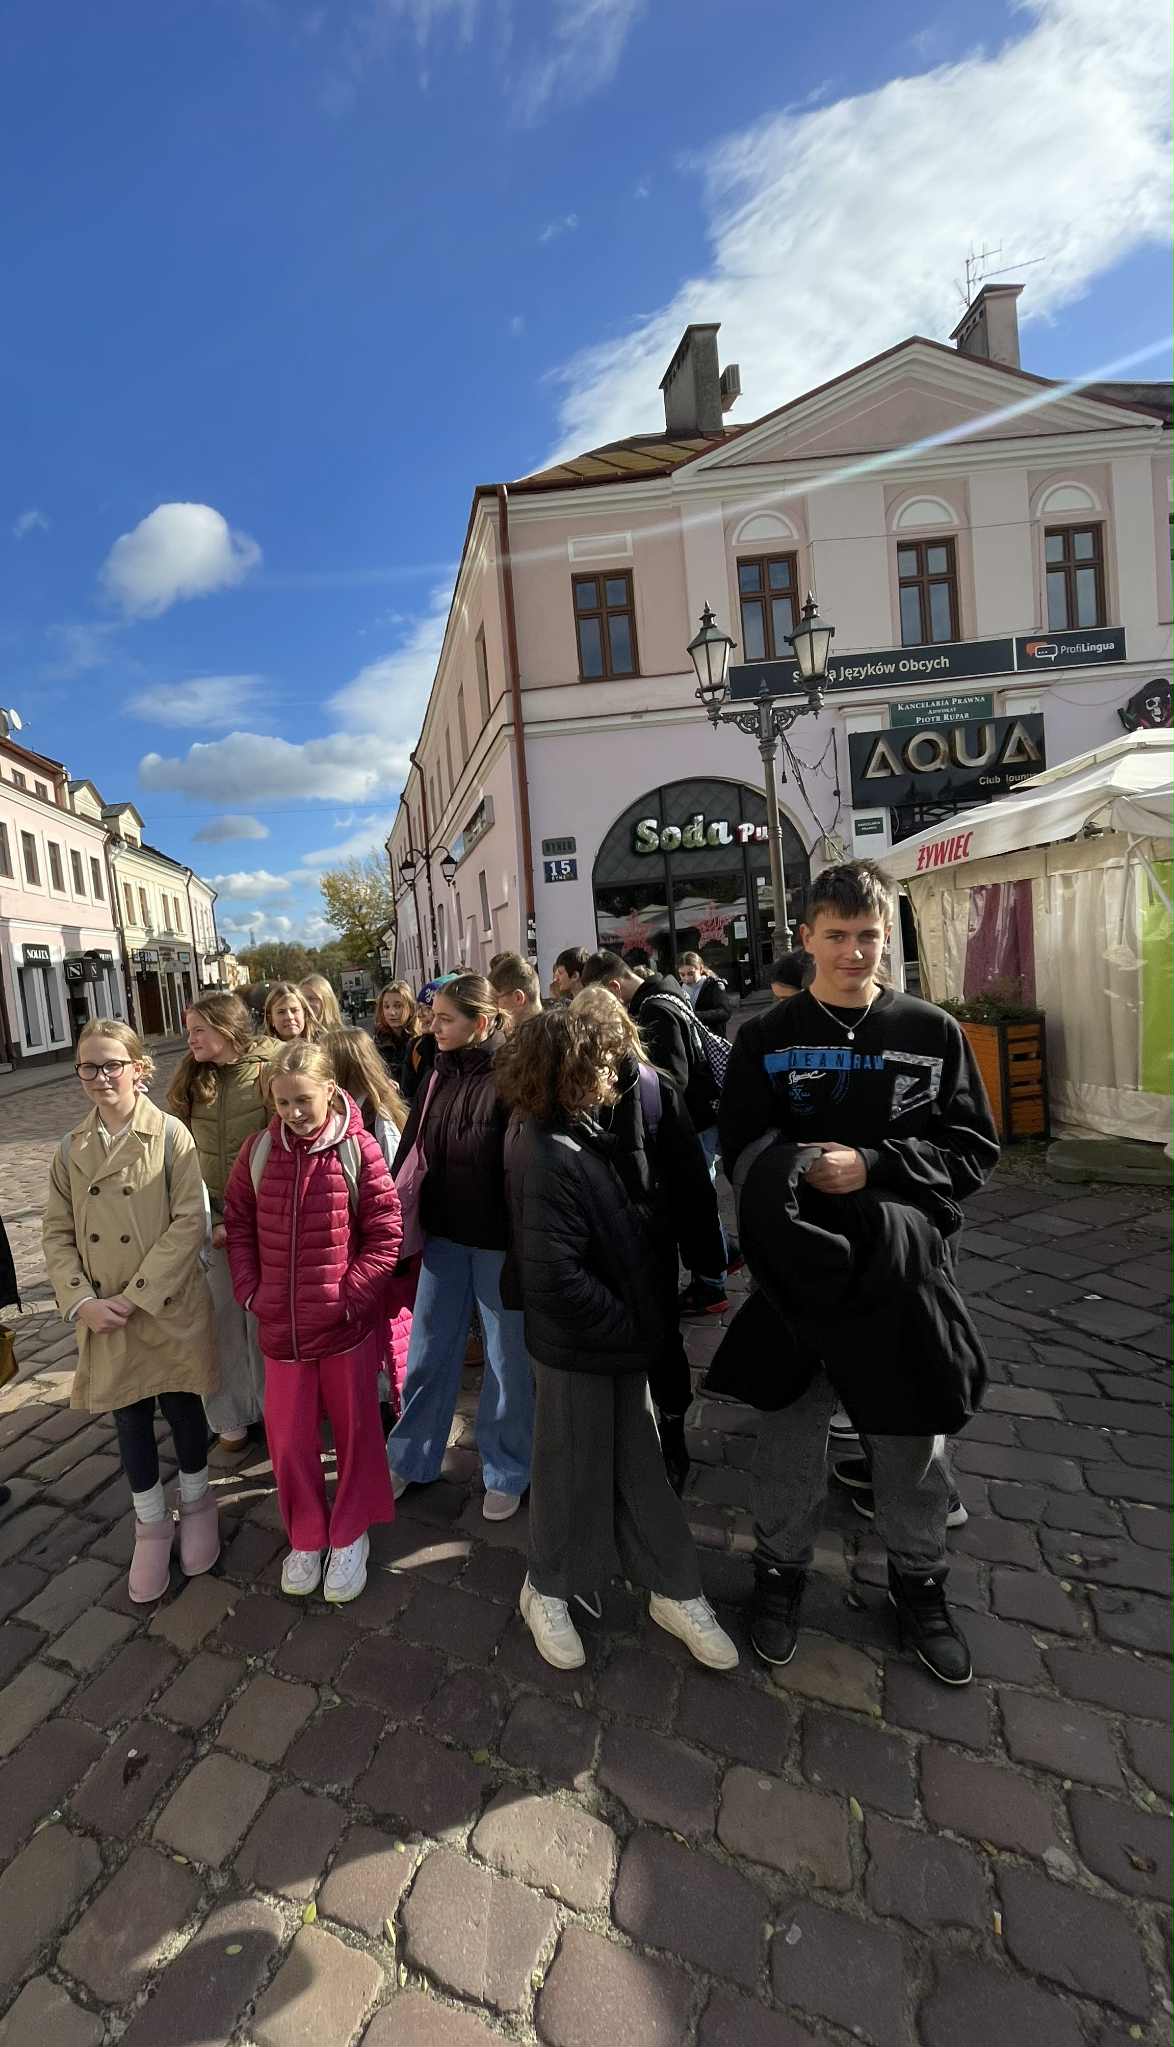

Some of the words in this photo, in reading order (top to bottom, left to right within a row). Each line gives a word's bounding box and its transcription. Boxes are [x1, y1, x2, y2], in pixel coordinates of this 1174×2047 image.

[1060, 642, 1115, 655] ProfiLingua
[839, 662, 896, 682] Języków
[899, 656, 950, 673] Obcych
[951, 696, 985, 705] PRAWNA
[864, 721, 1041, 779] AQUA
[979, 775, 1001, 785] Club
[635, 813, 734, 853] Soda
[737, 822, 770, 844] Pu
[916, 832, 974, 871] ŻYWIEC
[550, 860, 571, 876] 15
